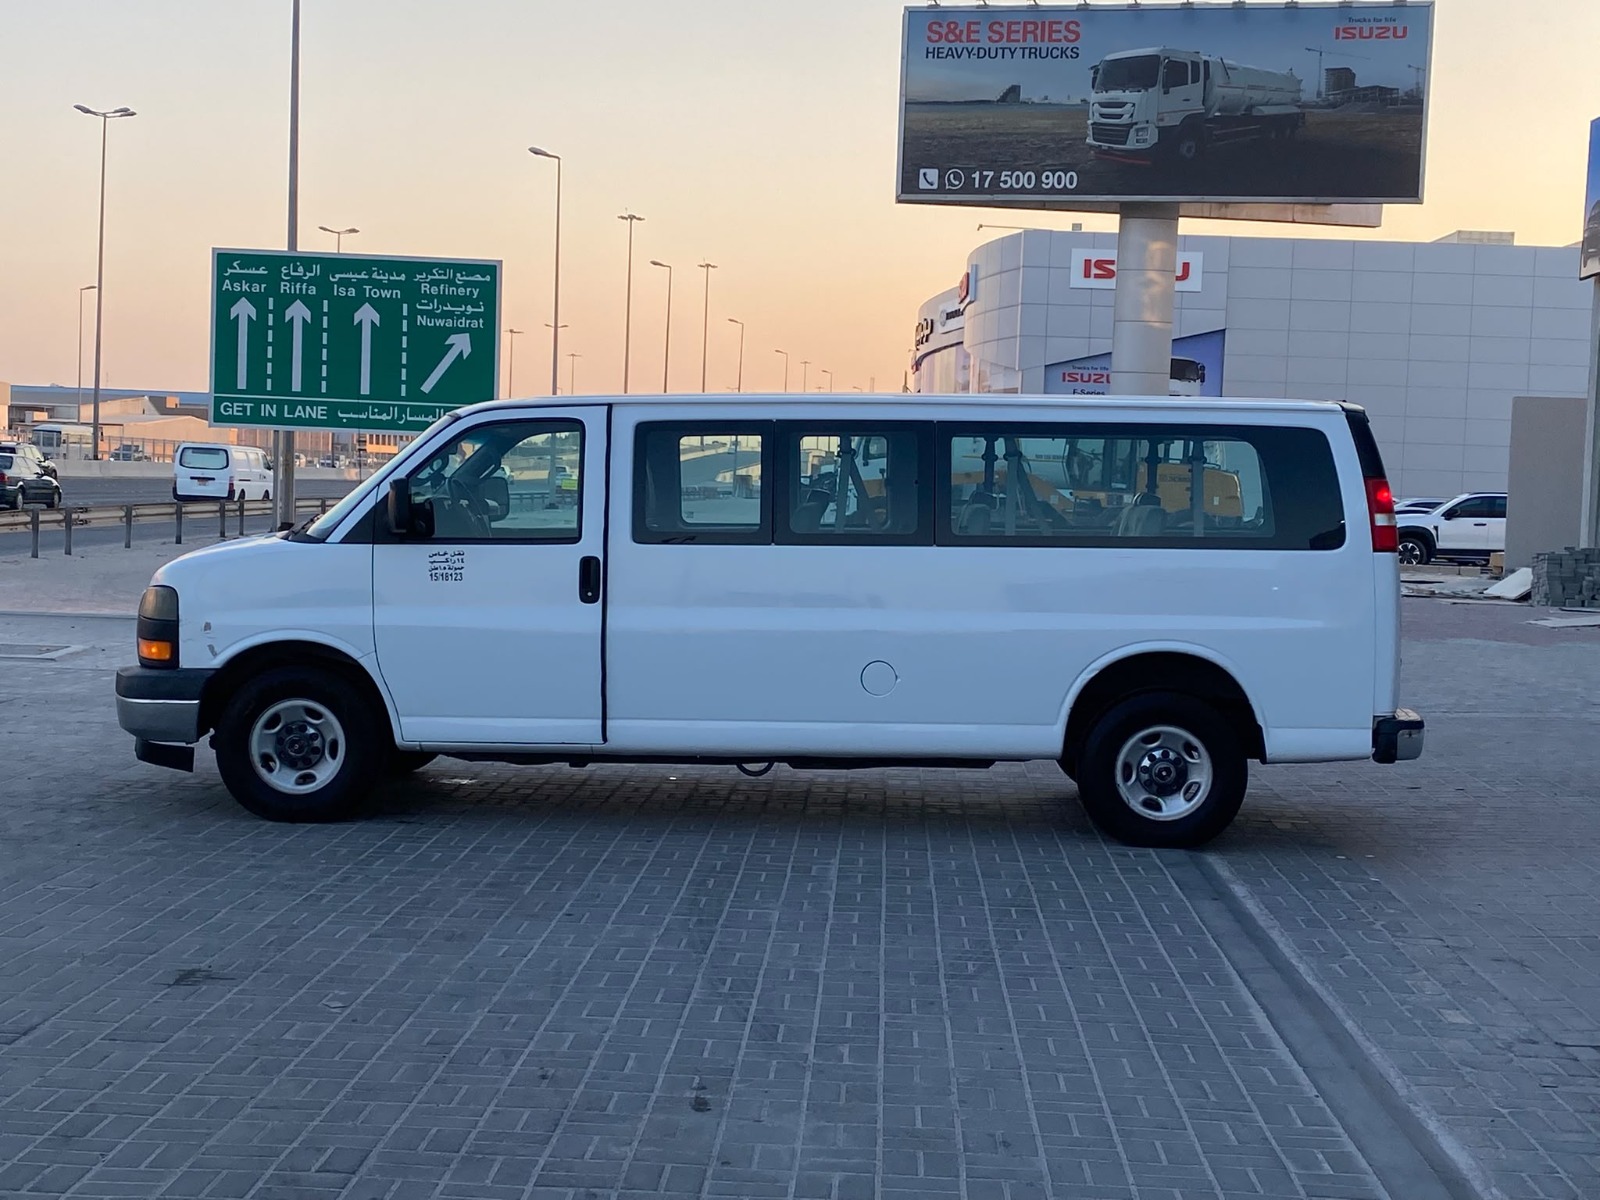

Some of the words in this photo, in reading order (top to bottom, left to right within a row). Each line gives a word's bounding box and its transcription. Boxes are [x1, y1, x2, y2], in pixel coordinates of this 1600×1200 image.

[927, 20, 981, 43] S&E
[987, 20, 1081, 43] SERIES
[1335, 25, 1408, 40] ISUZU
[925, 46, 1019, 60] HEAVY-DUTY
[1019, 46, 1080, 60] TRUCKS
[971, 170, 994, 188] 17
[999, 170, 1036, 189] 500
[1041, 170, 1078, 189] 900
[223, 260, 268, 276] عسكر
[281, 261, 320, 280] الرفاع
[329, 269, 369, 282] عيسى
[371, 267, 406, 283] مدينة
[412, 267, 453, 282] التكرير
[455, 270, 491, 283] مصنع
[222, 279, 267, 293] Askar
[280, 281, 317, 295] Riffa
[333, 284, 356, 297] Isa
[363, 285, 401, 299] Town
[421, 283, 480, 298] Refinery
[416, 299, 485, 314] نويدرات
[417, 315, 484, 329] Nuwaidrat
[220, 402, 254, 417] GET
[260, 403, 277, 418] IN
[284, 404, 328, 420] LANE
[337, 405, 397, 423] المناسب
[428, 550, 448, 558] خاص
